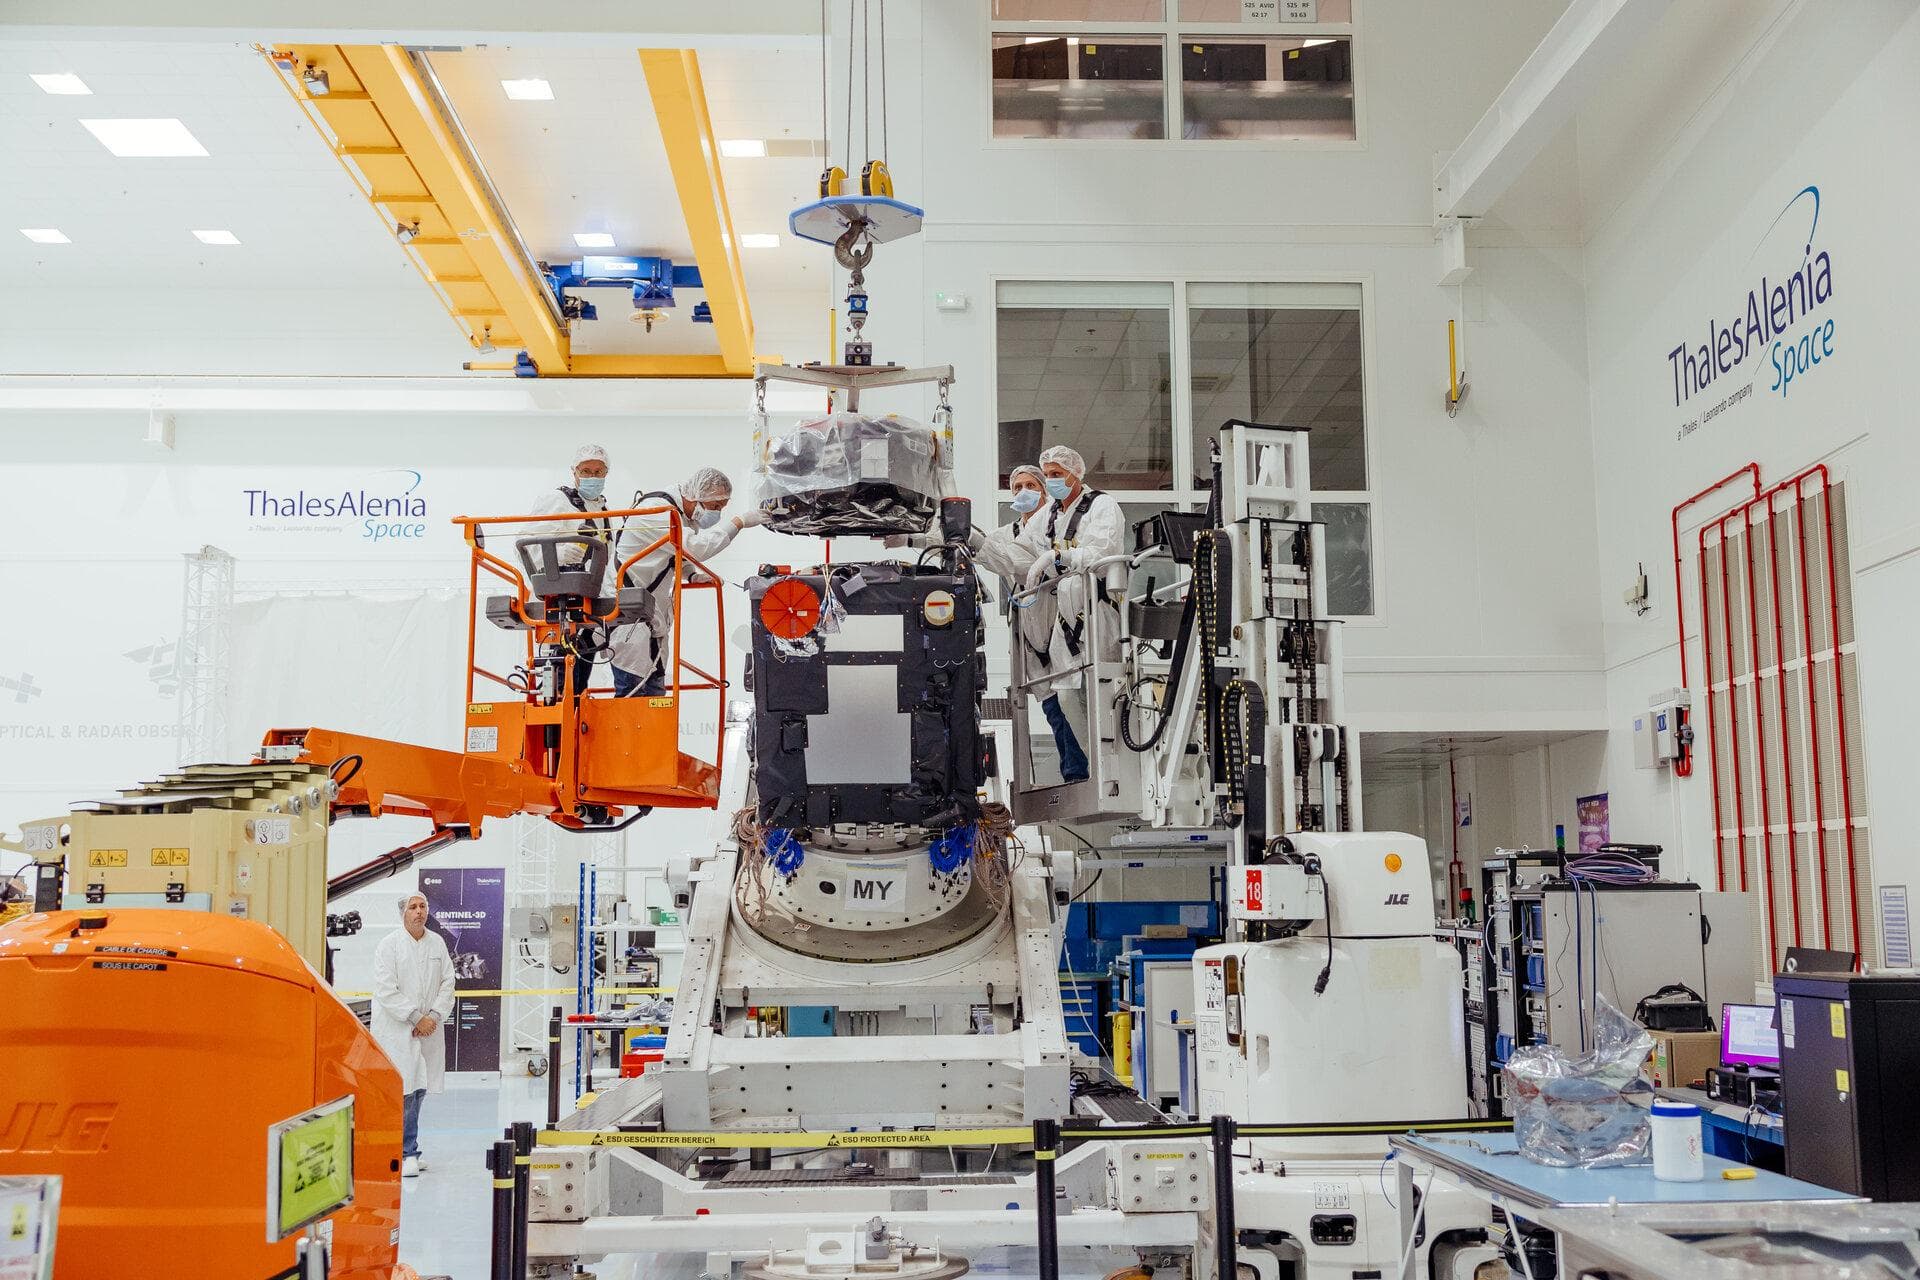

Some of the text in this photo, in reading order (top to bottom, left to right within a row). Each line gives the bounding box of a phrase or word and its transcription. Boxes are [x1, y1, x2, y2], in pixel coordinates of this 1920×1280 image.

[1668, 243, 1832, 407] ThalesAlenia
[1772, 319, 1834, 397] Space
[1682, 420, 1697, 437] Thales
[1703, 399, 1727, 423] Leonardo
[1728, 382, 1753, 407] company
[243, 490, 426, 517] ThalesAlenia
[363, 519, 426, 542] Space
[61, 725, 72, 738] &
[78, 725, 133, 738] RADAR
[853, 879, 894, 900] MY
[1247, 882, 1261, 901] 18
[1384, 894, 1409, 905] JLG
[435, 911, 487, 919] SENTINEL-3D
[137, 947, 168, 956] CHARGE
[606, 1134, 716, 1144] ESD GESCHÜTZTER BEREICH
[860, 1135, 907, 1143] PROTECTED
